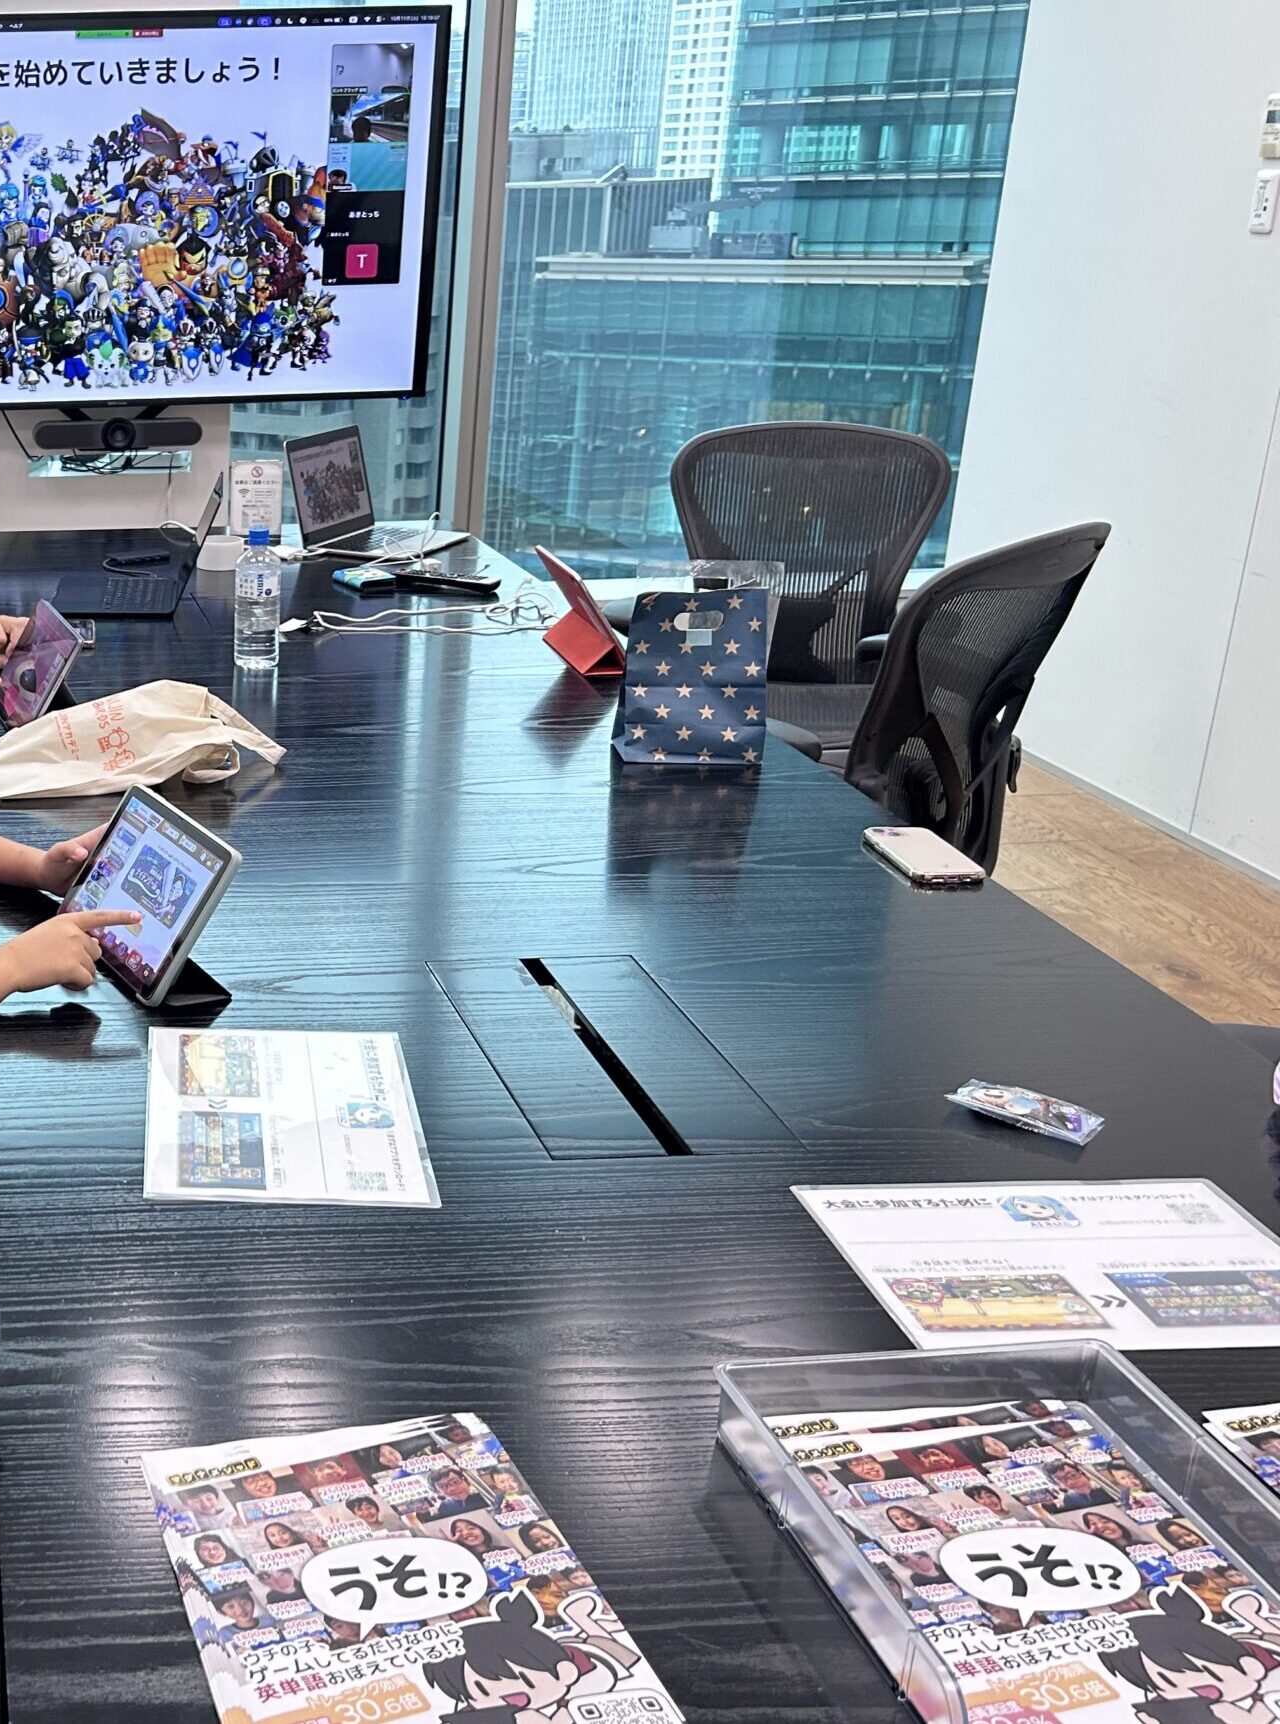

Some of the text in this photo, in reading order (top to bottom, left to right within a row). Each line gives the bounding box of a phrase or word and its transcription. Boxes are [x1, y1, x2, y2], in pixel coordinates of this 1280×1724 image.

[356, 253, 368, 269] T
[822, 1197, 992, 1209] 大会に参加するために
[926, 1624, 991, 1643] チの子、
[943, 1614, 1125, 1657] ームしてるだけなのに
[248, 1622, 461, 1684] ゲームしてるだけなのに
[953, 1630, 1132, 1679] 単語おぼえている!?
